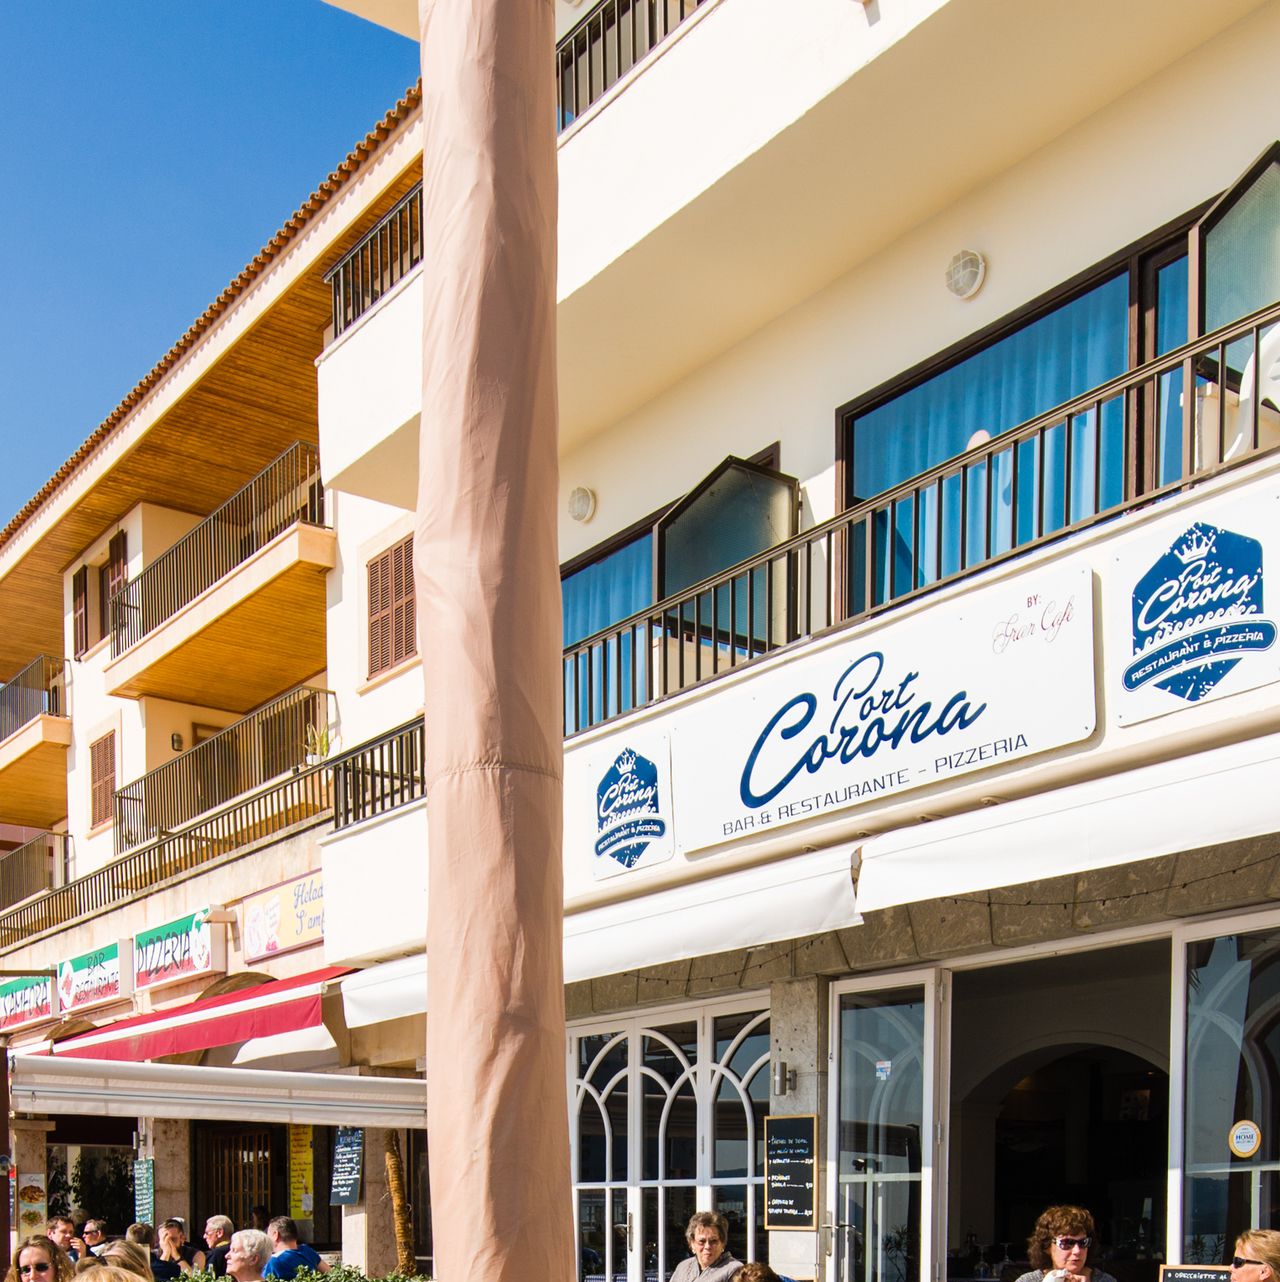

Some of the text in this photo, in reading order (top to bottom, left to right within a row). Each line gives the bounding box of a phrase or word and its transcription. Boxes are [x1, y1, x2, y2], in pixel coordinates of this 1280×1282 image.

[1179, 560, 1222, 596] Port
[1027, 594, 1041, 608] BY:
[1138, 575, 1258, 631] Corona
[1132, 632, 1264, 682] RESTAURANT & PIZZERIA
[830, 652, 919, 734] Port
[740, 690, 987, 809] Corona
[599, 783, 656, 817] Corona
[618, 773, 639, 793] Port
[723, 816, 755, 836] BAR
[760, 811, 773, 824] &
[779, 768, 910, 820] RESTAURANTE
[935, 733, 1029, 773] PIZZERIA
[87, 952, 106, 976] BAR
[137, 924, 190, 981] PIZZERIA
[75, 971, 119, 1002] RESTAURANTE
